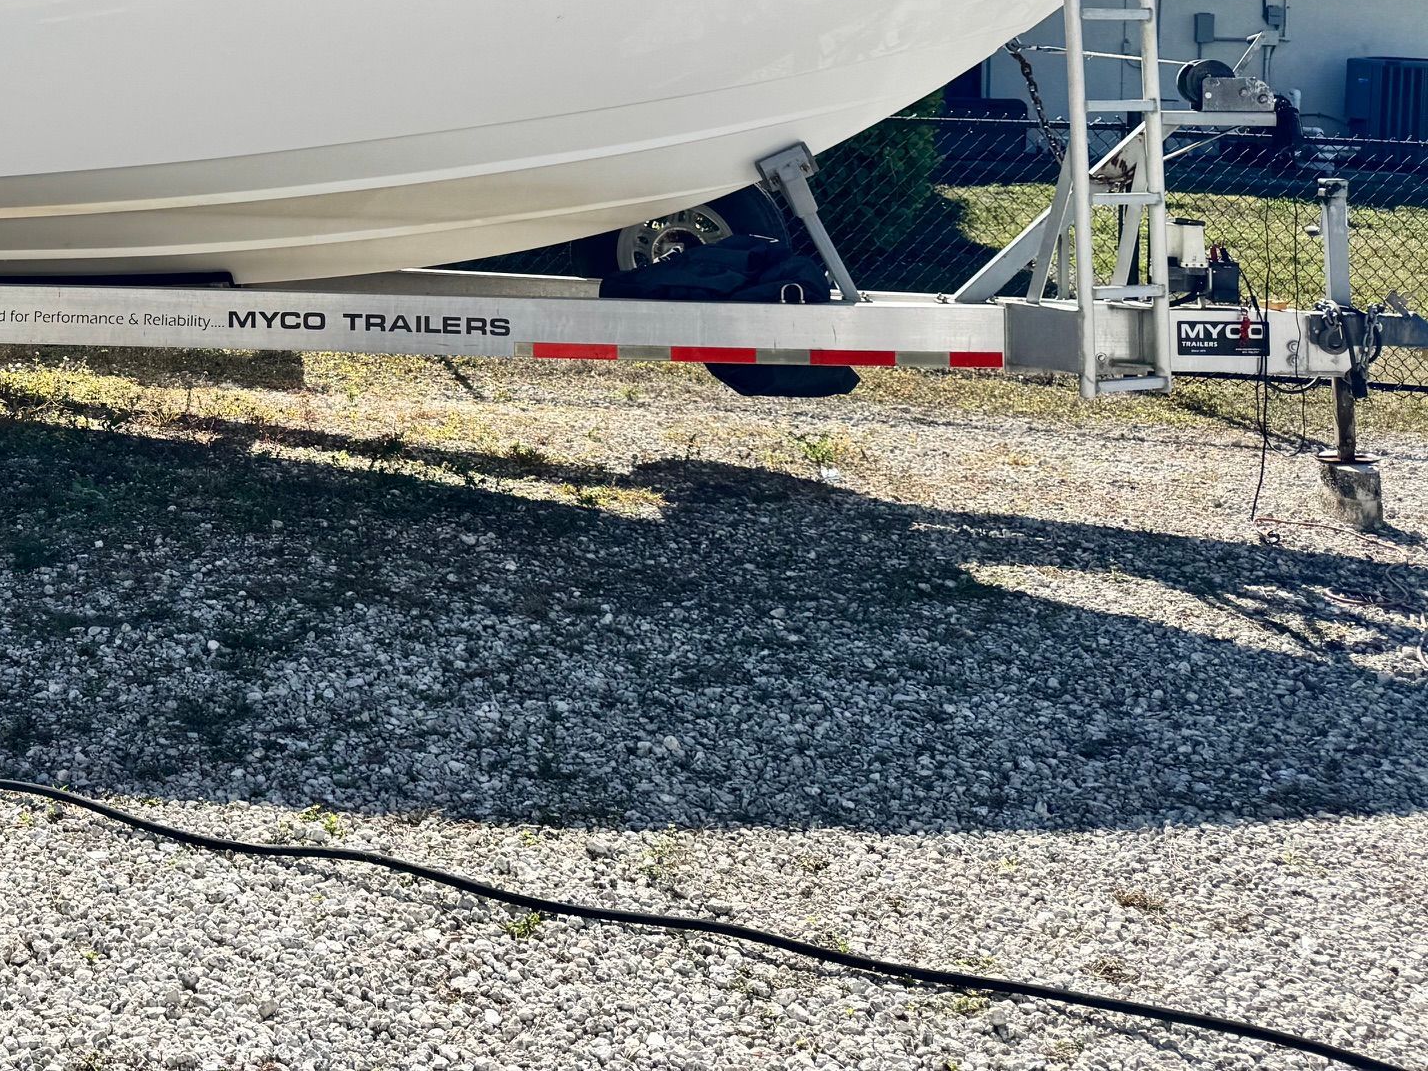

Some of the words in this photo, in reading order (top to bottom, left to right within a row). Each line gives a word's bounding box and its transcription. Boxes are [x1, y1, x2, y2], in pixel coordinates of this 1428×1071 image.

[10, 310, 30, 323] for
[34, 311, 124, 325] Performance
[128, 313, 139, 325] &
[228, 311, 326, 330] MYCO
[343, 313, 511, 337] TRAILERS
[1180, 323, 1264, 339] MYCO
